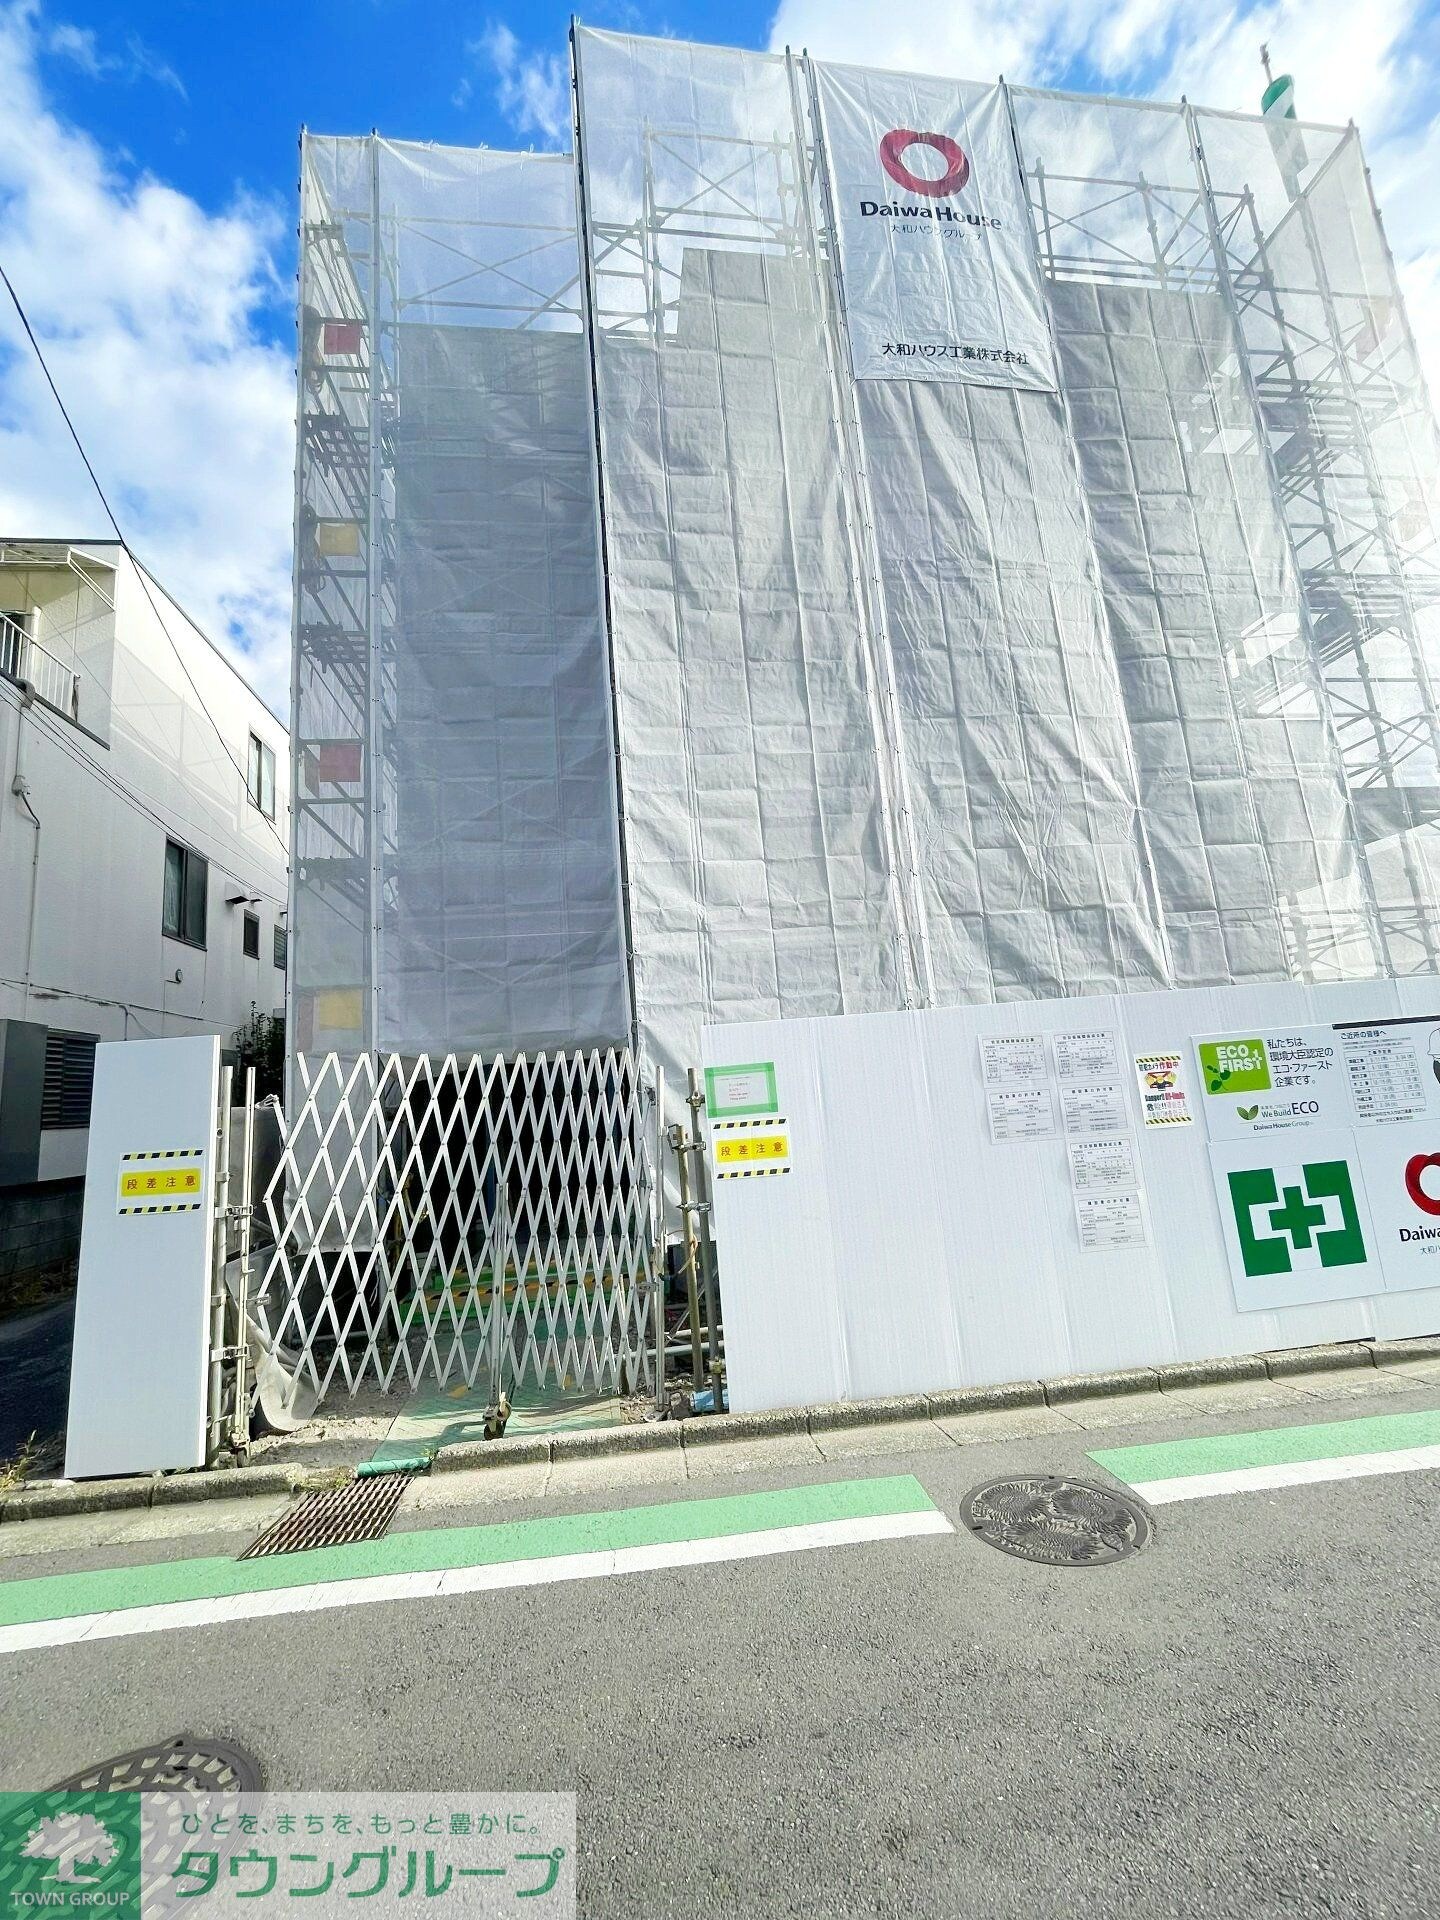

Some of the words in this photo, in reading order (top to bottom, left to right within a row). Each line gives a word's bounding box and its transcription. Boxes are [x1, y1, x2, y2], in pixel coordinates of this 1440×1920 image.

[882, 343, 1029, 365] 大和ハウス工業株式会社
[1267, 1037, 1307, 1049] 私たちは、
[1216, 1044, 1249, 1059] ECO
[1270, 1047, 1334, 1061] 環境大臣認定の
[1273, 1060, 1333, 1074] エコ・ファースト
[1275, 1075, 1316, 1087] 企業です。
[1273, 1108, 1291, 1117] Build
[1291, 1101, 1319, 1115] ECO
[721, 1141, 783, 1157] 段差注意
[127, 1175, 196, 1190] 段差注意
